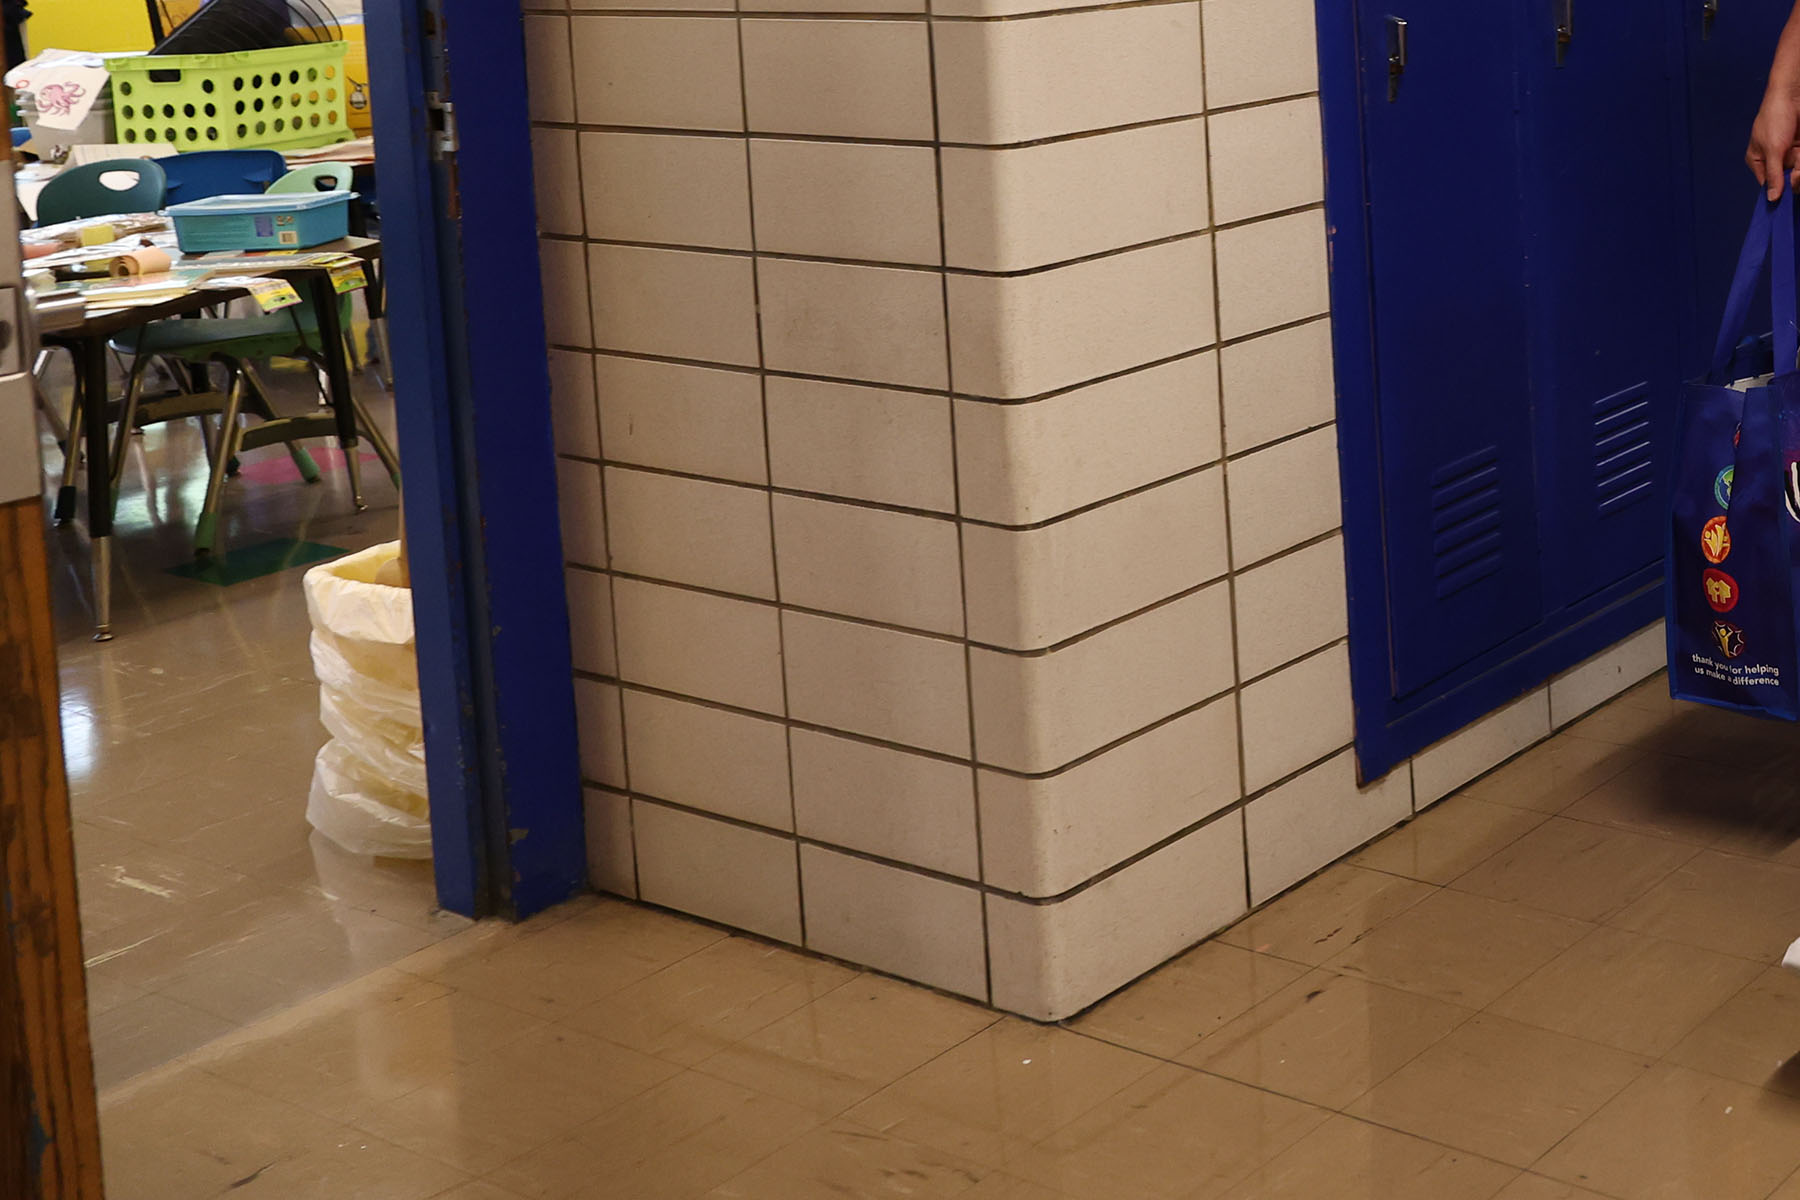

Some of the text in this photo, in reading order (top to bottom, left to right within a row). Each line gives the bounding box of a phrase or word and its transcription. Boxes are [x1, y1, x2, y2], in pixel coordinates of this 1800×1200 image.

[1692, 653, 1713, 667] thank
[1714, 661, 1728, 672] you
[1744, 664, 1779, 677] helping
[1694, 667, 1704, 675] us
[1706, 668, 1725, 681] make
[1732, 676, 1780, 686] difference
